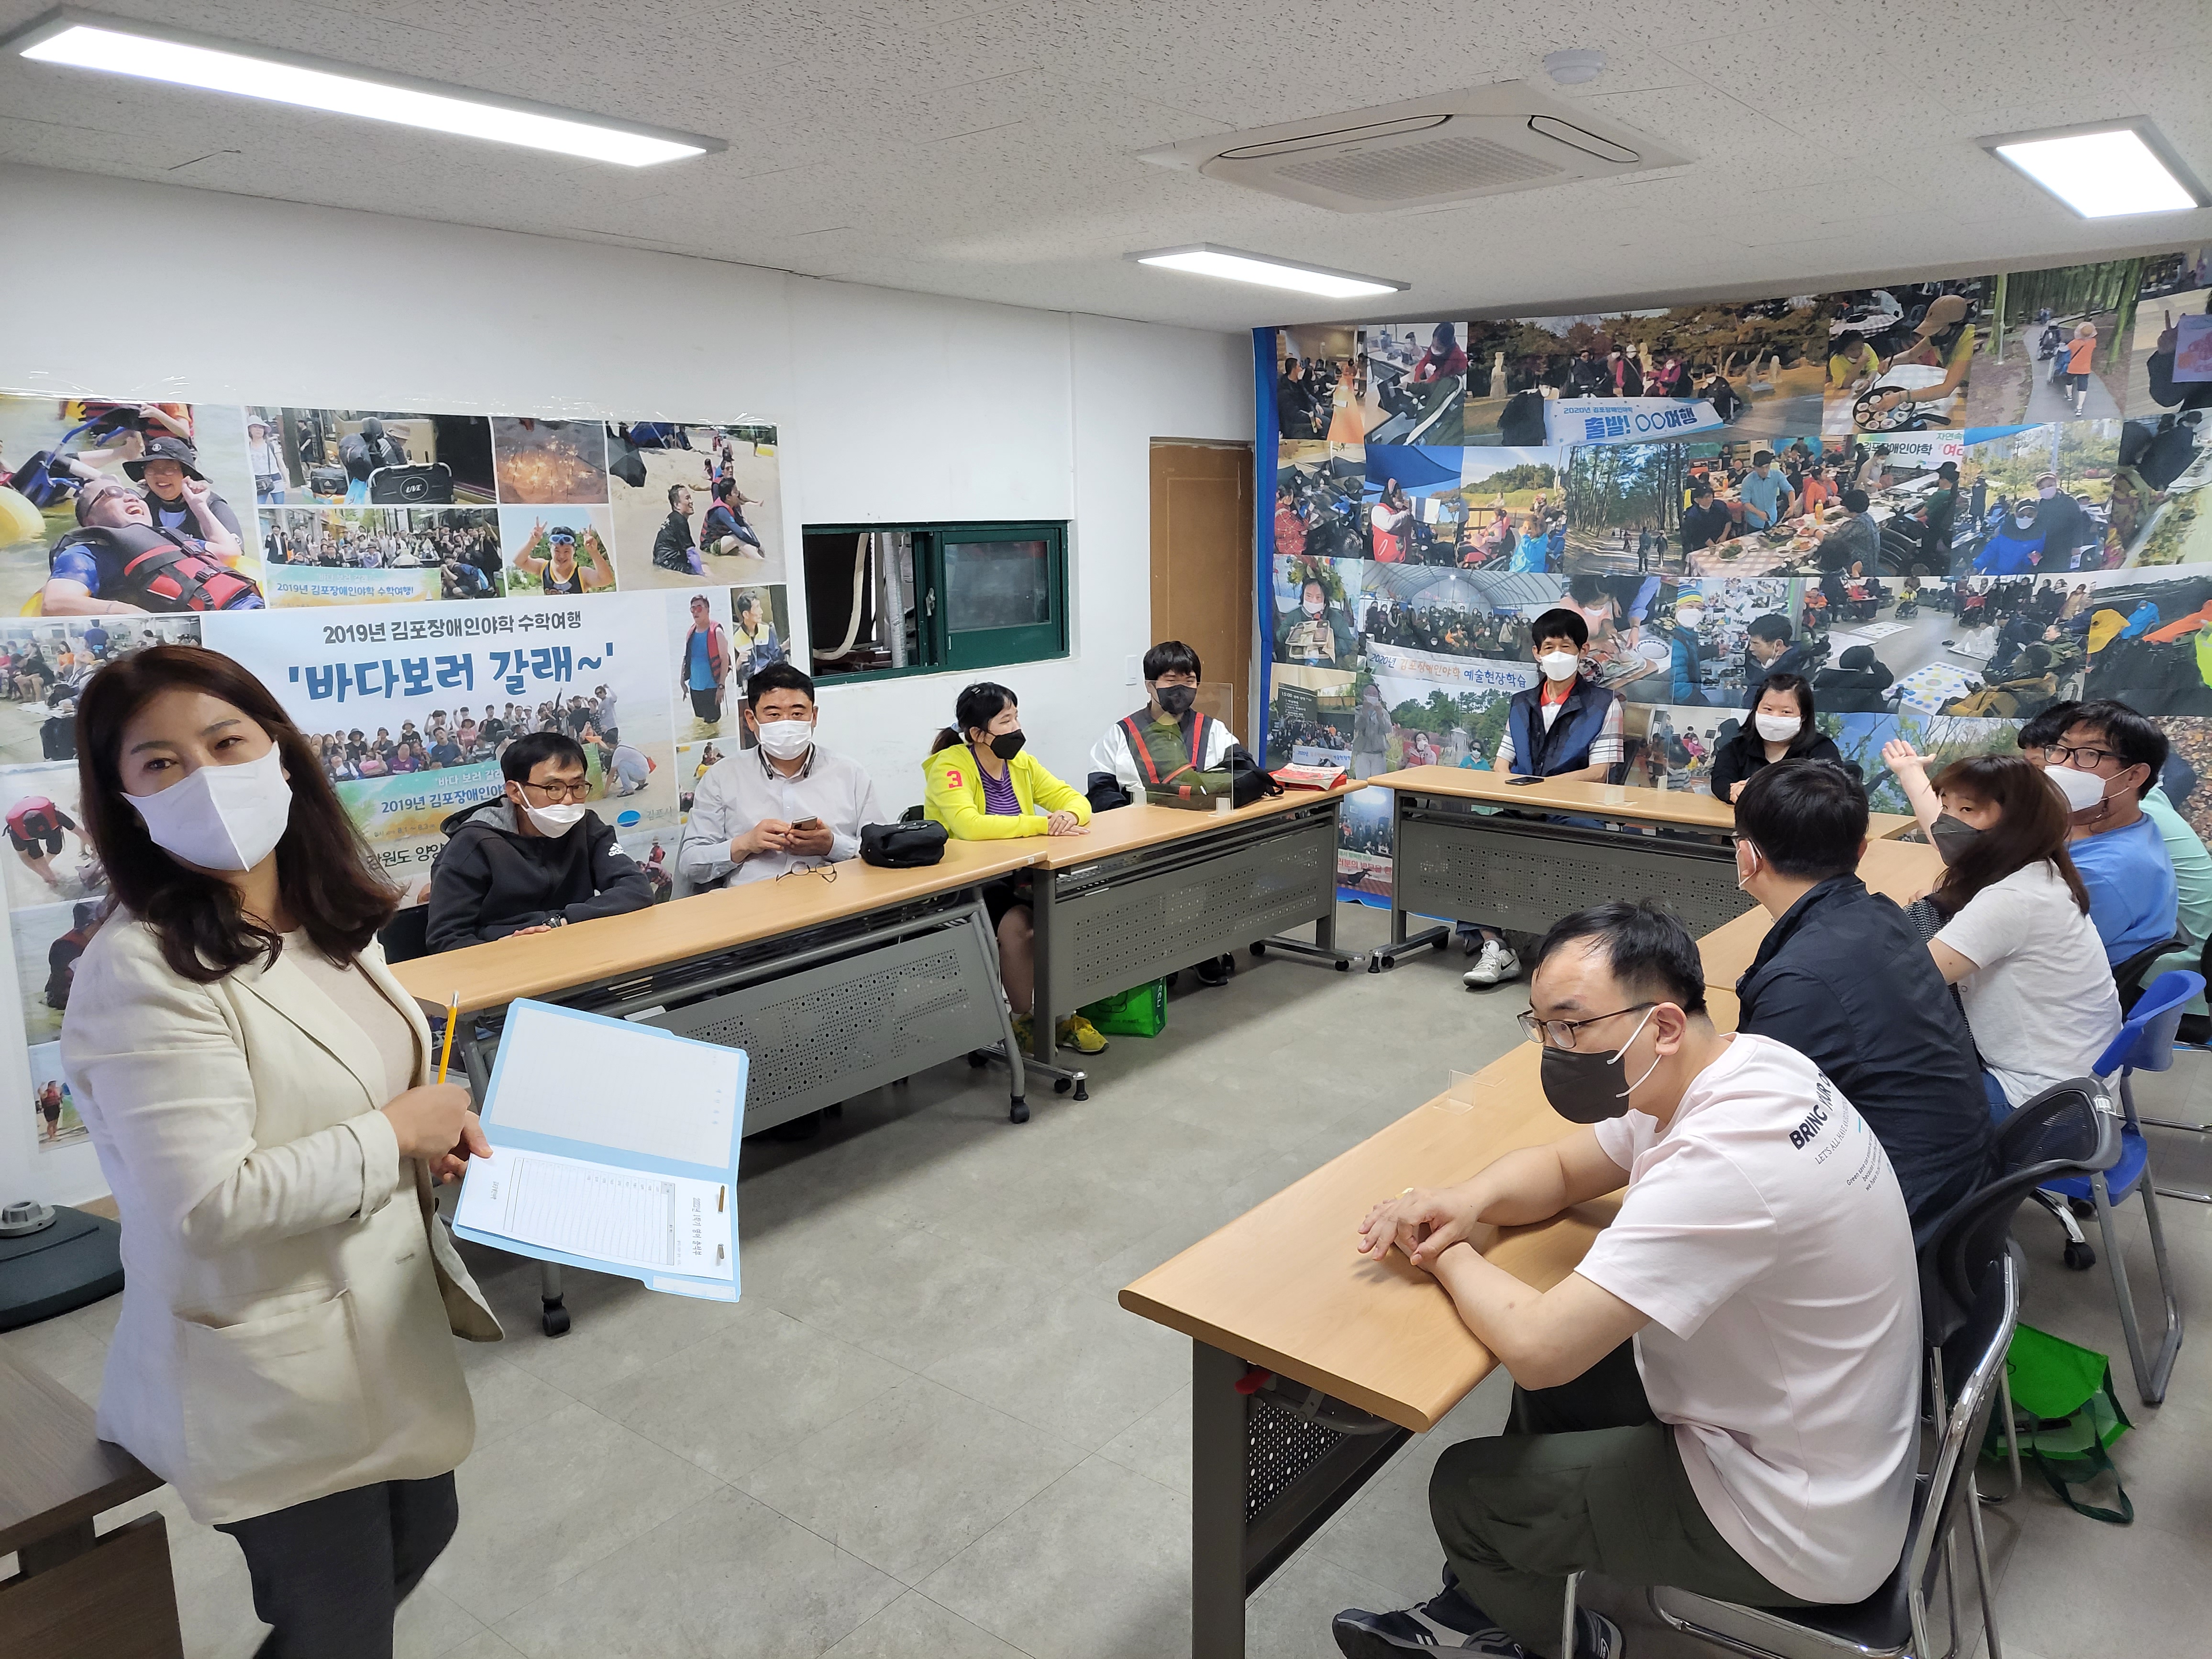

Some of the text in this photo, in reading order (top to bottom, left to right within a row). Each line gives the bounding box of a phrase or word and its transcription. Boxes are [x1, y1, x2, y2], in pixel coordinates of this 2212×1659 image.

[1585, 415, 1631, 440] 출발!
[277, 583, 414, 596] 2019년 김포장애인야학 수학여행!
[322, 610, 582, 644] 2019년 김포장애인야학 수학여행
[288, 642, 613, 703] '바다보러 갈래~'
[1369, 653, 1527, 688] 2020년 김포장애인야학 예술현장학습
[462, 772, 481, 783] 보러
[947, 771, 962, 788] 3
[381, 784, 506, 813] 2019년 김포장애인야
[647, 806, 673, 821] 김포시
[1789, 1105, 1828, 1150] BRING
[1816, 1083, 1833, 1112] YOUR
[1815, 1147, 1832, 1164] LET'S
[1830, 1138, 1840, 1151] ALL
[1847, 1172, 1860, 1186] Green
[1862, 1165, 1874, 1182] because
[692, 1240, 702, 1256] 출석부
